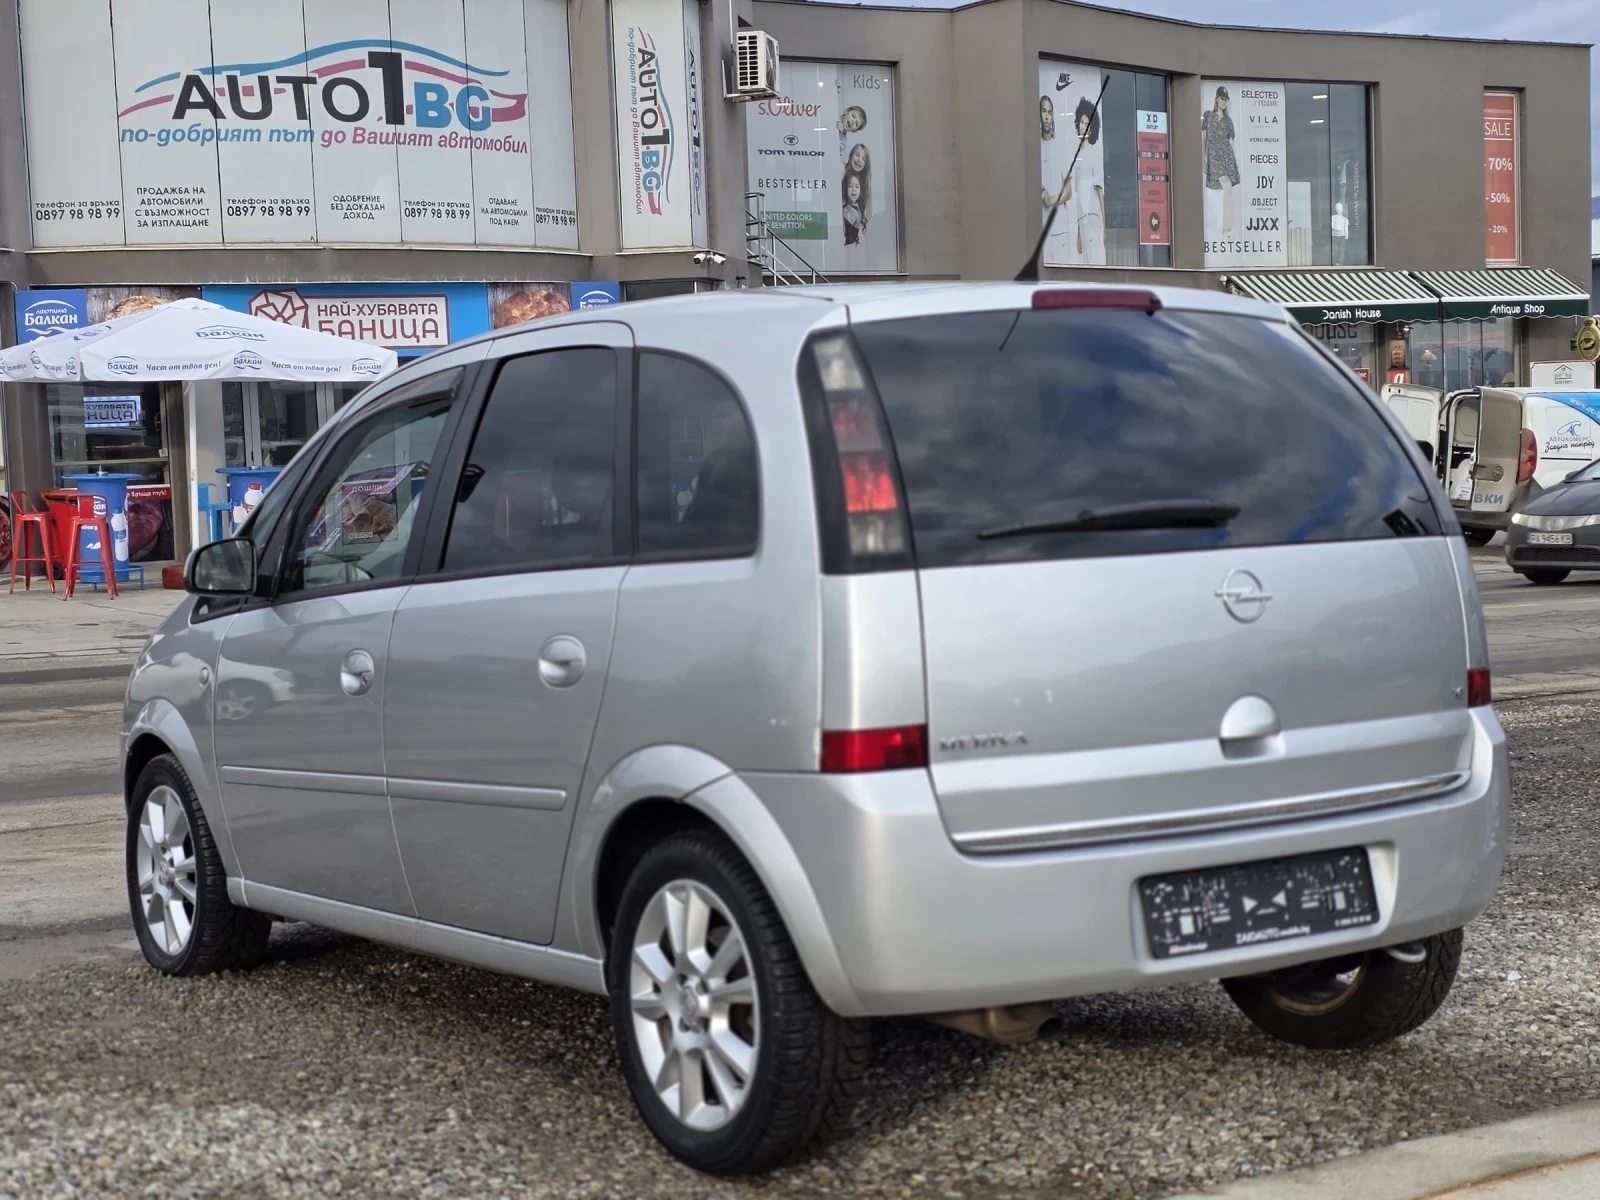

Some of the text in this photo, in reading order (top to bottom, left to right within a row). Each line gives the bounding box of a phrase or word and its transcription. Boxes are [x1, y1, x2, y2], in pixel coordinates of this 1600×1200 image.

[854, 75, 880, 90] Kids
[1058, 72, 1070, 83] NIKE
[1241, 90, 1278, 99] SELECTED
[1484, 122, 1511, 136] SALE
[120, 123, 528, 153] по-добрият път до Вашият автомобил
[1250, 154, 1278, 164] PIECES
[758, 178, 826, 188] BESTSELLER
[1256, 176, 1274, 188] JDY
[140, 198, 204, 206] АВТОМОБИЛИ
[226, 197, 266, 206] телефон
[280, 198, 310, 206] връзка
[332, 195, 380, 203] ОДОБРЕНИЕ
[488, 198, 518, 206] ОТДАВАНЕ
[36, 208, 120, 221] 0897 98 98 99
[144, 208, 210, 216] ВЪЗМОЖНОСТ
[226, 206, 310, 216] 0897 98 98 99
[342, 212, 374, 220] ДОХОД
[404, 208, 470, 220] 0897 98 98 99
[151, 219, 209, 228] ИЗПЛАЩАНЕ
[489, 218, 502, 226] ПОД
[1246, 218, 1279, 230] JJXX
[1204, 240, 1281, 253] BESTSELLER
[317, 300, 438, 316] НАЙ-ХУБАВАТА
[1490, 304, 1545, 315] Antique Shop
[24, 312, 78, 326] Балкан
[1323, 308, 1382, 320] Danish House
[318, 318, 439, 343] БАНИЦА
[108, 362, 138, 370] Балкан
[233, 357, 262, 365] Балкан
[271, 361, 291, 369] Част
[352, 364, 382, 372] Балкан
[87, 410, 133, 421] НИЦА
